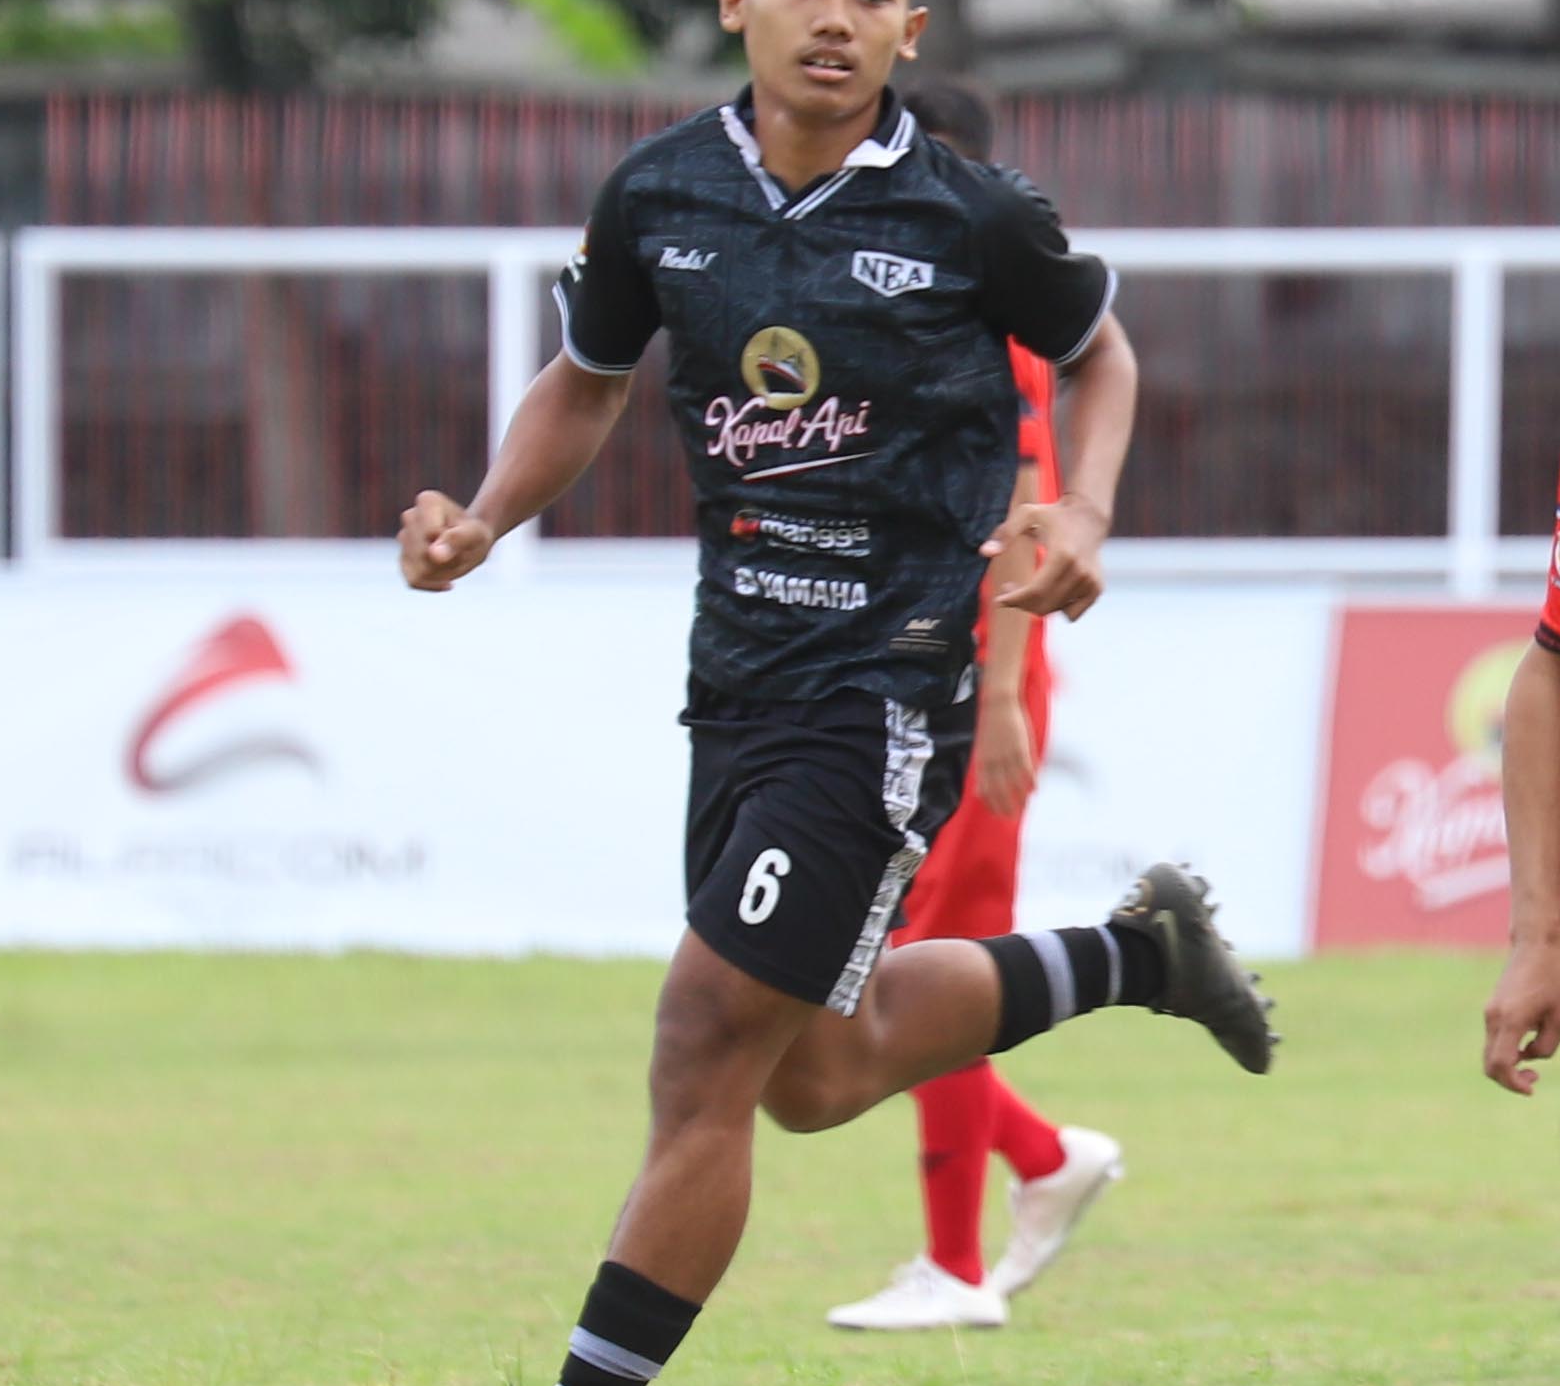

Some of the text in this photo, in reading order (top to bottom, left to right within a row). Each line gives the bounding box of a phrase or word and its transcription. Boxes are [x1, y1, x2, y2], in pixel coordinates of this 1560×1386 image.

[858, 256, 925, 291] NEA
[704, 395, 872, 467] Kapal Api
[756, 570, 868, 611] YAMAHA
[738, 847, 792, 925] 6
